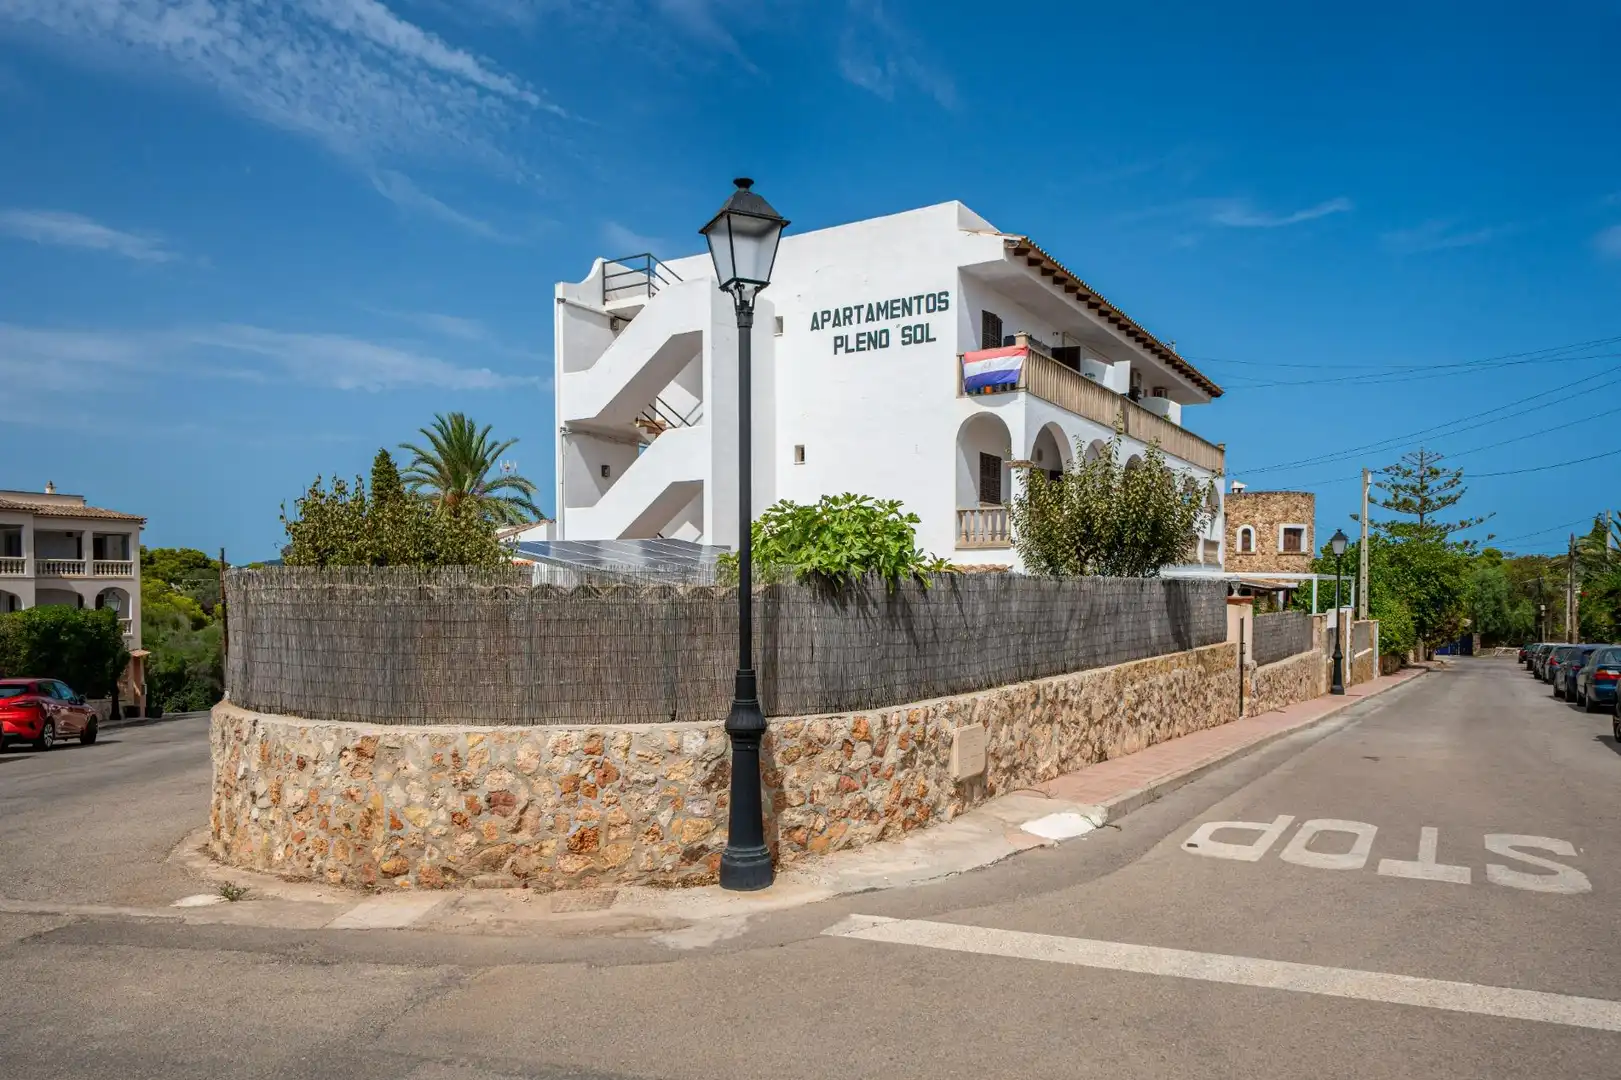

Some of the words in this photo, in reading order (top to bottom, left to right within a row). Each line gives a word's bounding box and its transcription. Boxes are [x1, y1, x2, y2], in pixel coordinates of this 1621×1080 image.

[810, 290, 949, 331] APARTAMENTOS
[833, 328, 890, 355] PLENO
[901, 322, 937, 346] SOL
[1180, 814, 1592, 894] STOP
